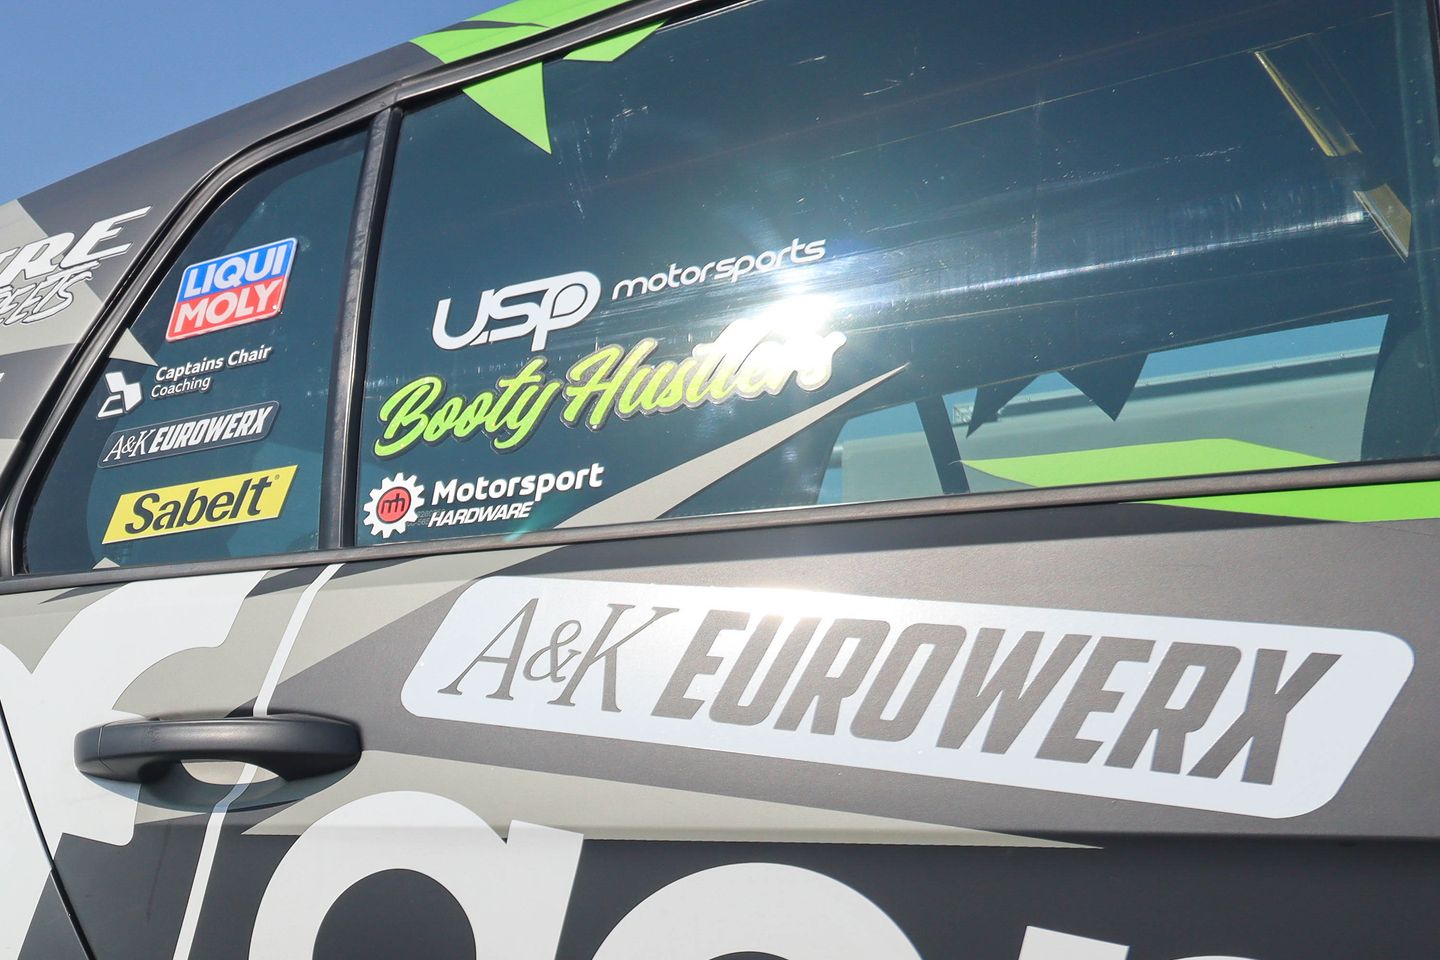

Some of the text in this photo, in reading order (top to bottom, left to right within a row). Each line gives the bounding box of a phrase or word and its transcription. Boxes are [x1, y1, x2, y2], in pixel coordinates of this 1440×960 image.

[183, 244, 289, 299] LIQUI
[432, 238, 827, 351] USP motorsports
[173, 281, 281, 335] MOLY
[151, 374, 211, 400] Coaching
[155, 343, 271, 382] Captains Chair
[104, 405, 274, 462] A&K EUROWERX
[374, 356, 560, 457] Booty
[124, 475, 271, 534] Sabelt
[431, 462, 605, 508] Motorsport
[428, 500, 533, 528] HARDWARE
[439, 596, 1342, 786] A&K EUROWERX
